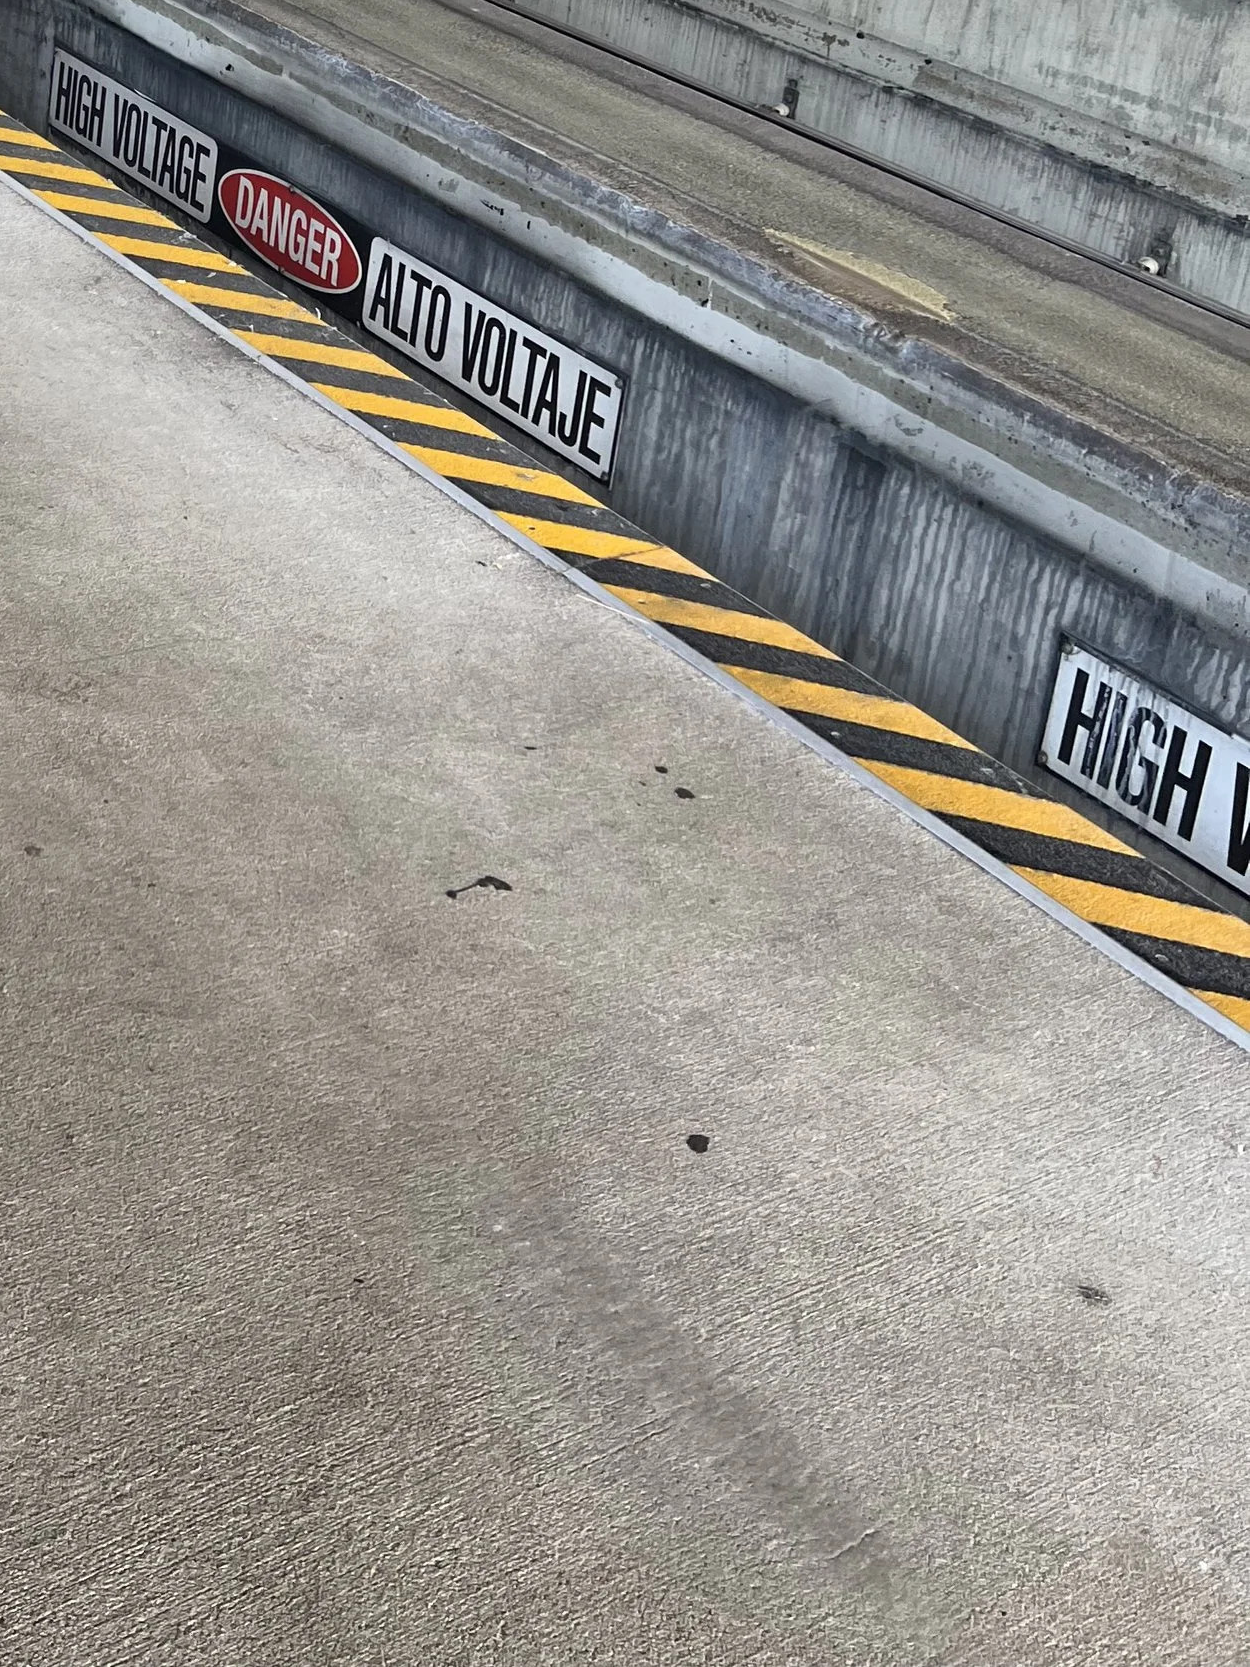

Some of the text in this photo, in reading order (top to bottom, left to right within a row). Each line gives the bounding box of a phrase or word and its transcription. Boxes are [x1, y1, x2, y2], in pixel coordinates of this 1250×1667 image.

[54, 61, 211, 214] HIGH VOLTAGE
[234, 174, 342, 287] DANGER
[369, 253, 612, 466] ALTO VOLTAJE
[1057, 667, 1213, 842] HIGH
